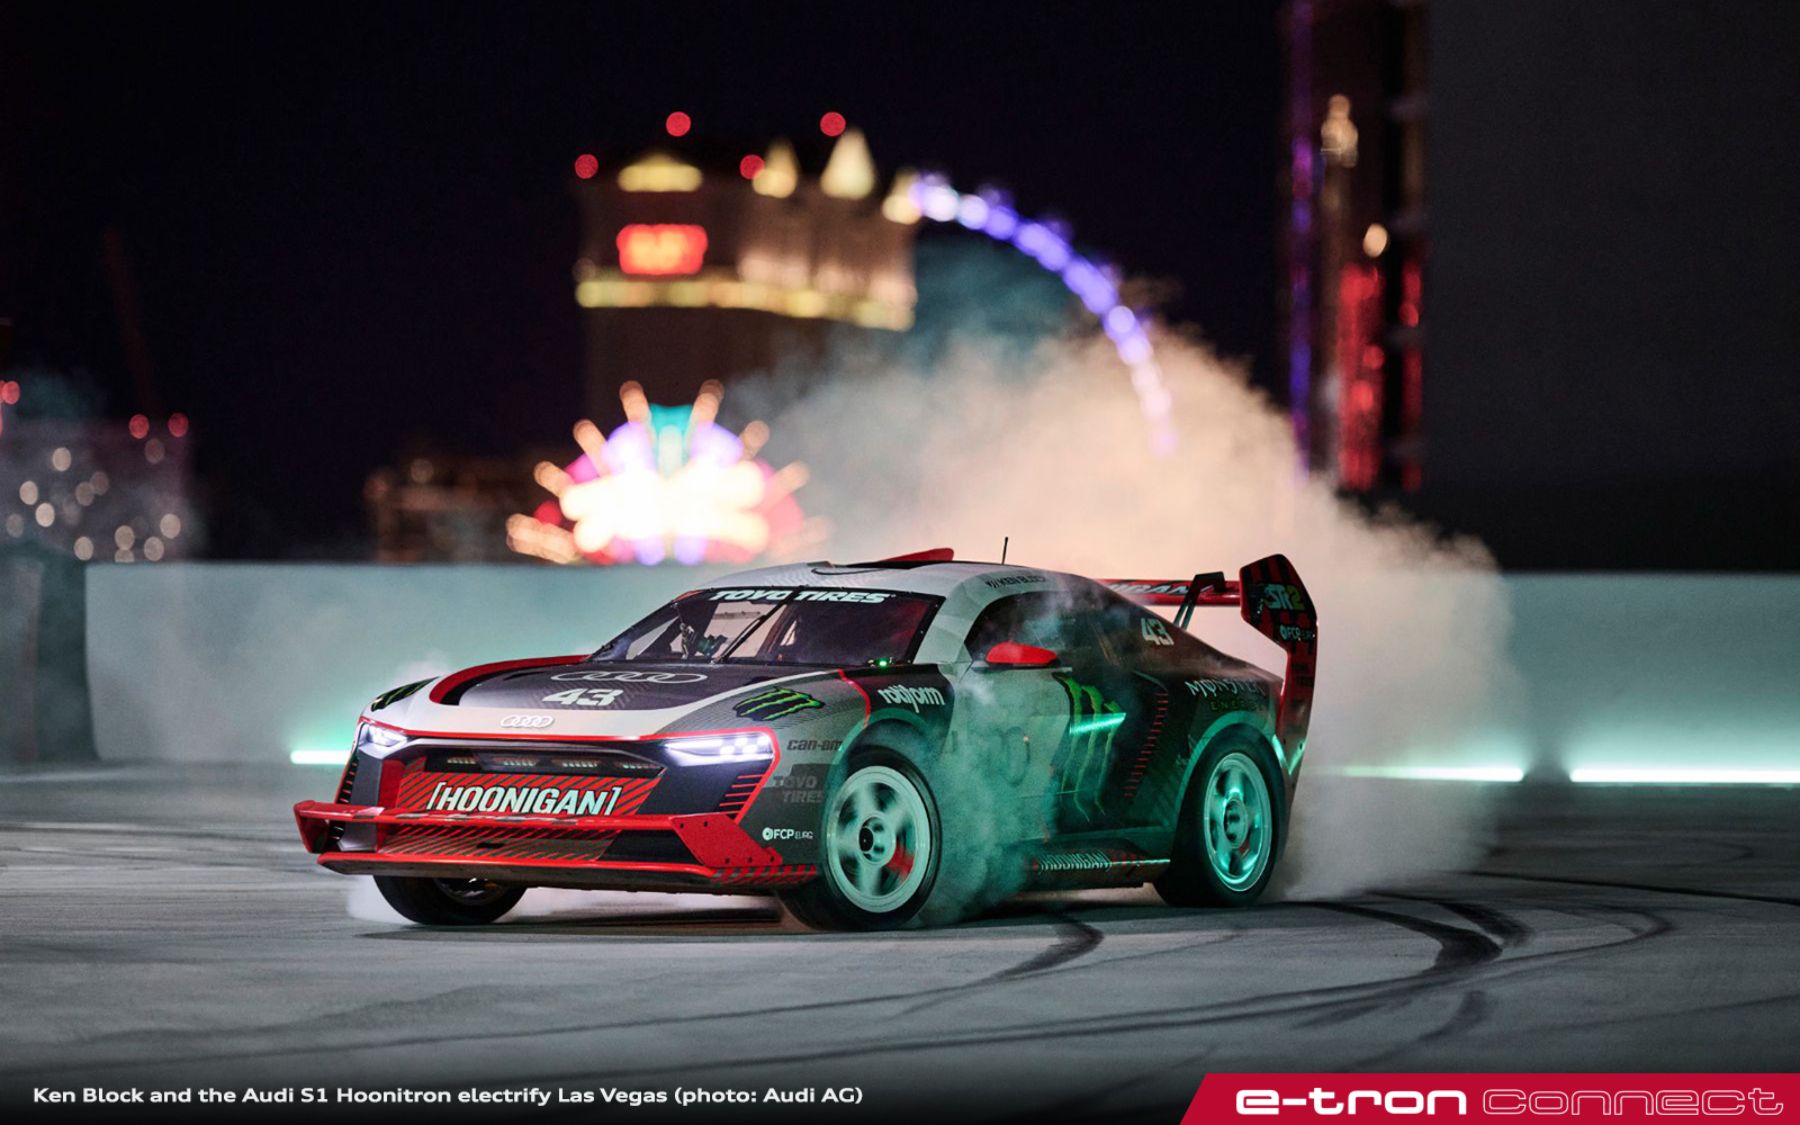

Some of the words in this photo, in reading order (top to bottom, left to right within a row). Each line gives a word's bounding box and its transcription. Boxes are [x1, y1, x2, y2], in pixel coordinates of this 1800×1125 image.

[707, 590, 793, 601] TOYO
[794, 590, 892, 604] TIRES
[1140, 616, 1175, 646] 43
[542, 687, 624, 706] 43
[786, 740, 842, 752] can-am
[773, 775, 818, 789] TOYO
[426, 781, 623, 816] [HOONIGAN]
[773, 828, 795, 840] FCP
